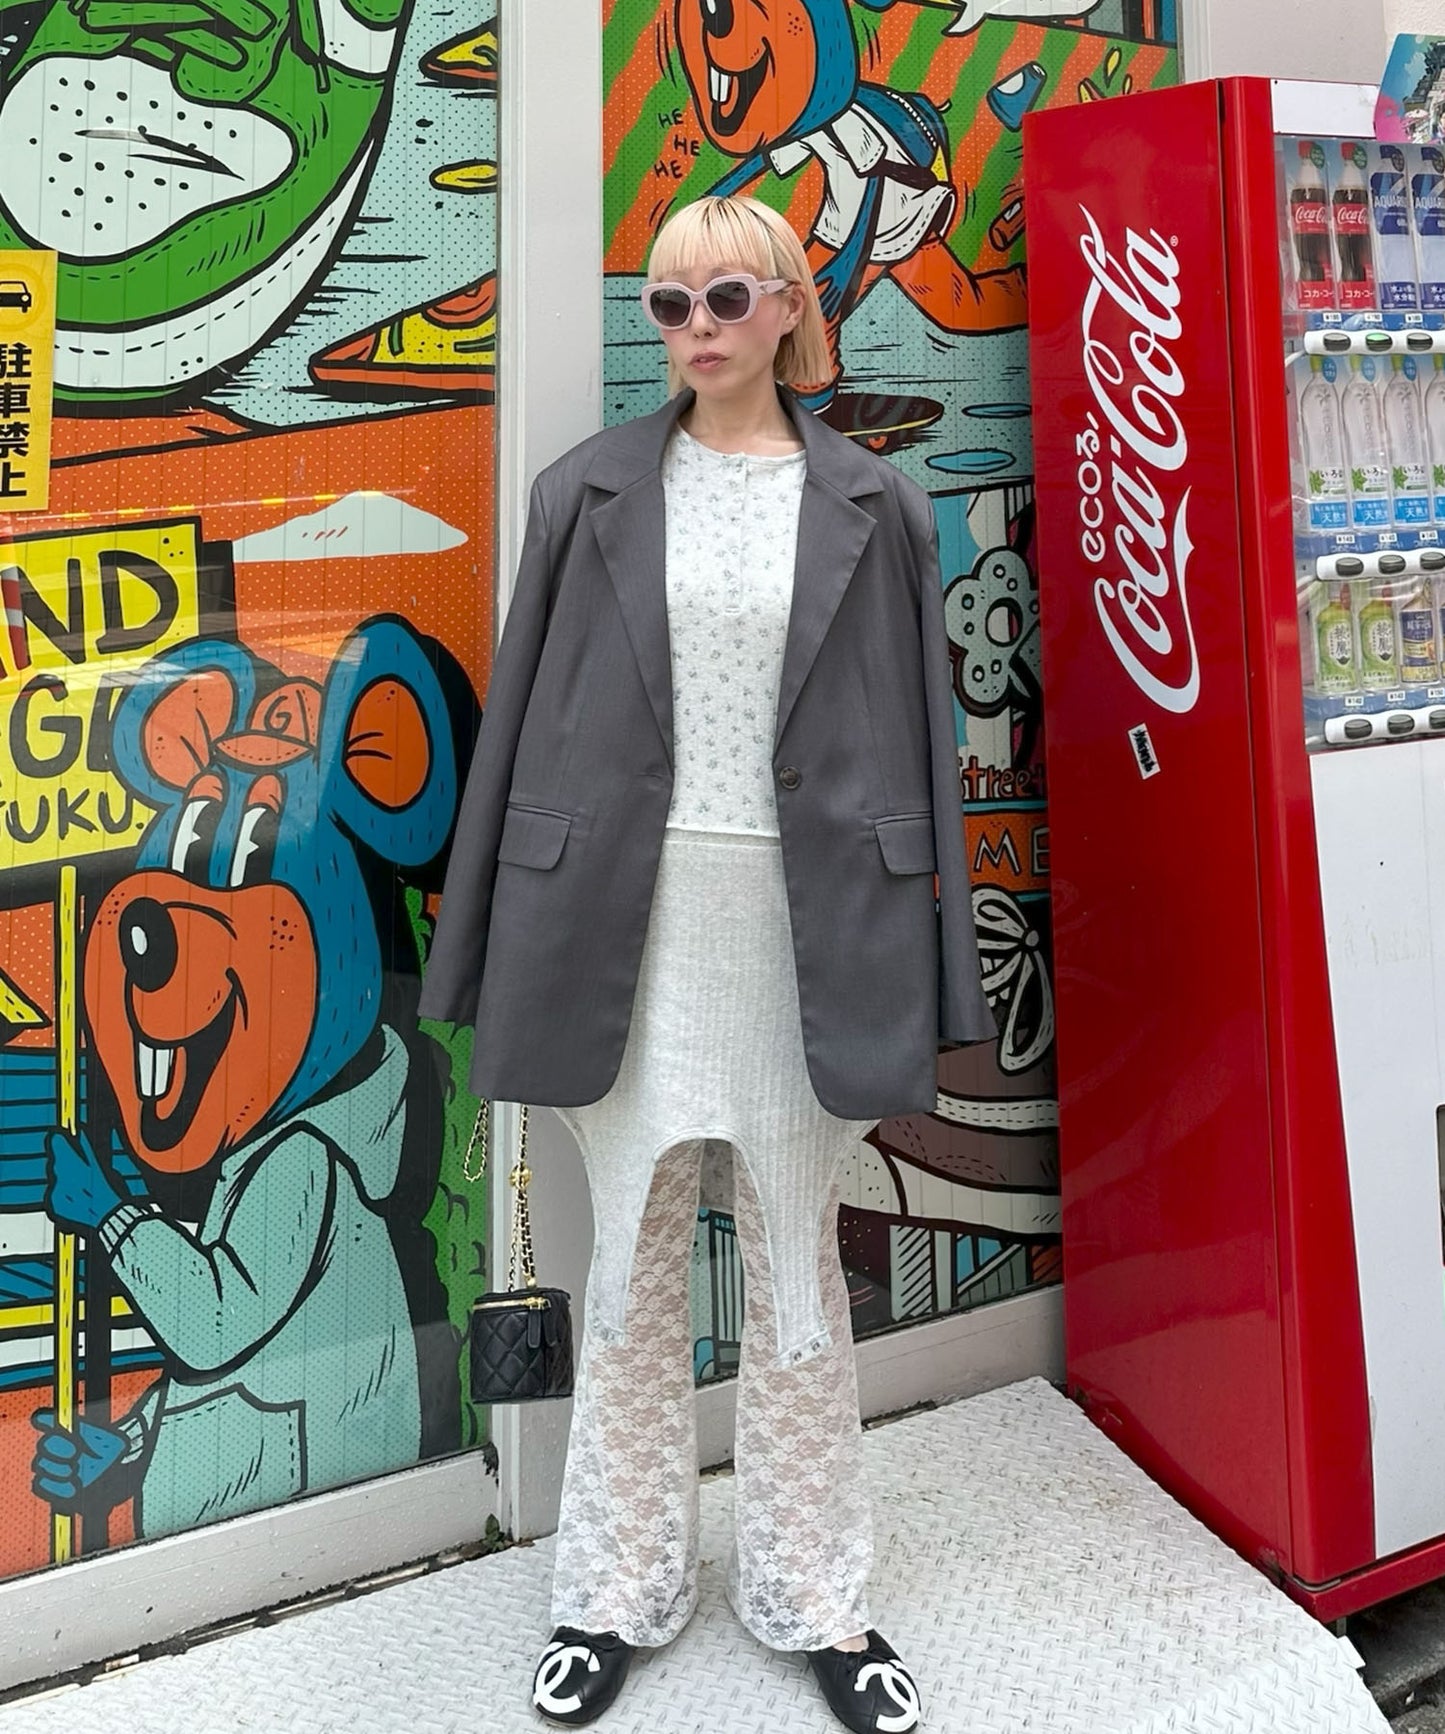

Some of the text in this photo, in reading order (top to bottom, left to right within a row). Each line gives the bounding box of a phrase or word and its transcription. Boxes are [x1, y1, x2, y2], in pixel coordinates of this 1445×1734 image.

[658, 108, 684, 128] HE
[673, 134, 701, 156] HE
[653, 160, 683, 179] HE
[1080, 203, 1200, 714] Coca-Cola
[0, 550, 180, 680] ND
[958, 755, 1047, 799] treet
[0, 788, 144, 843] UKU.
